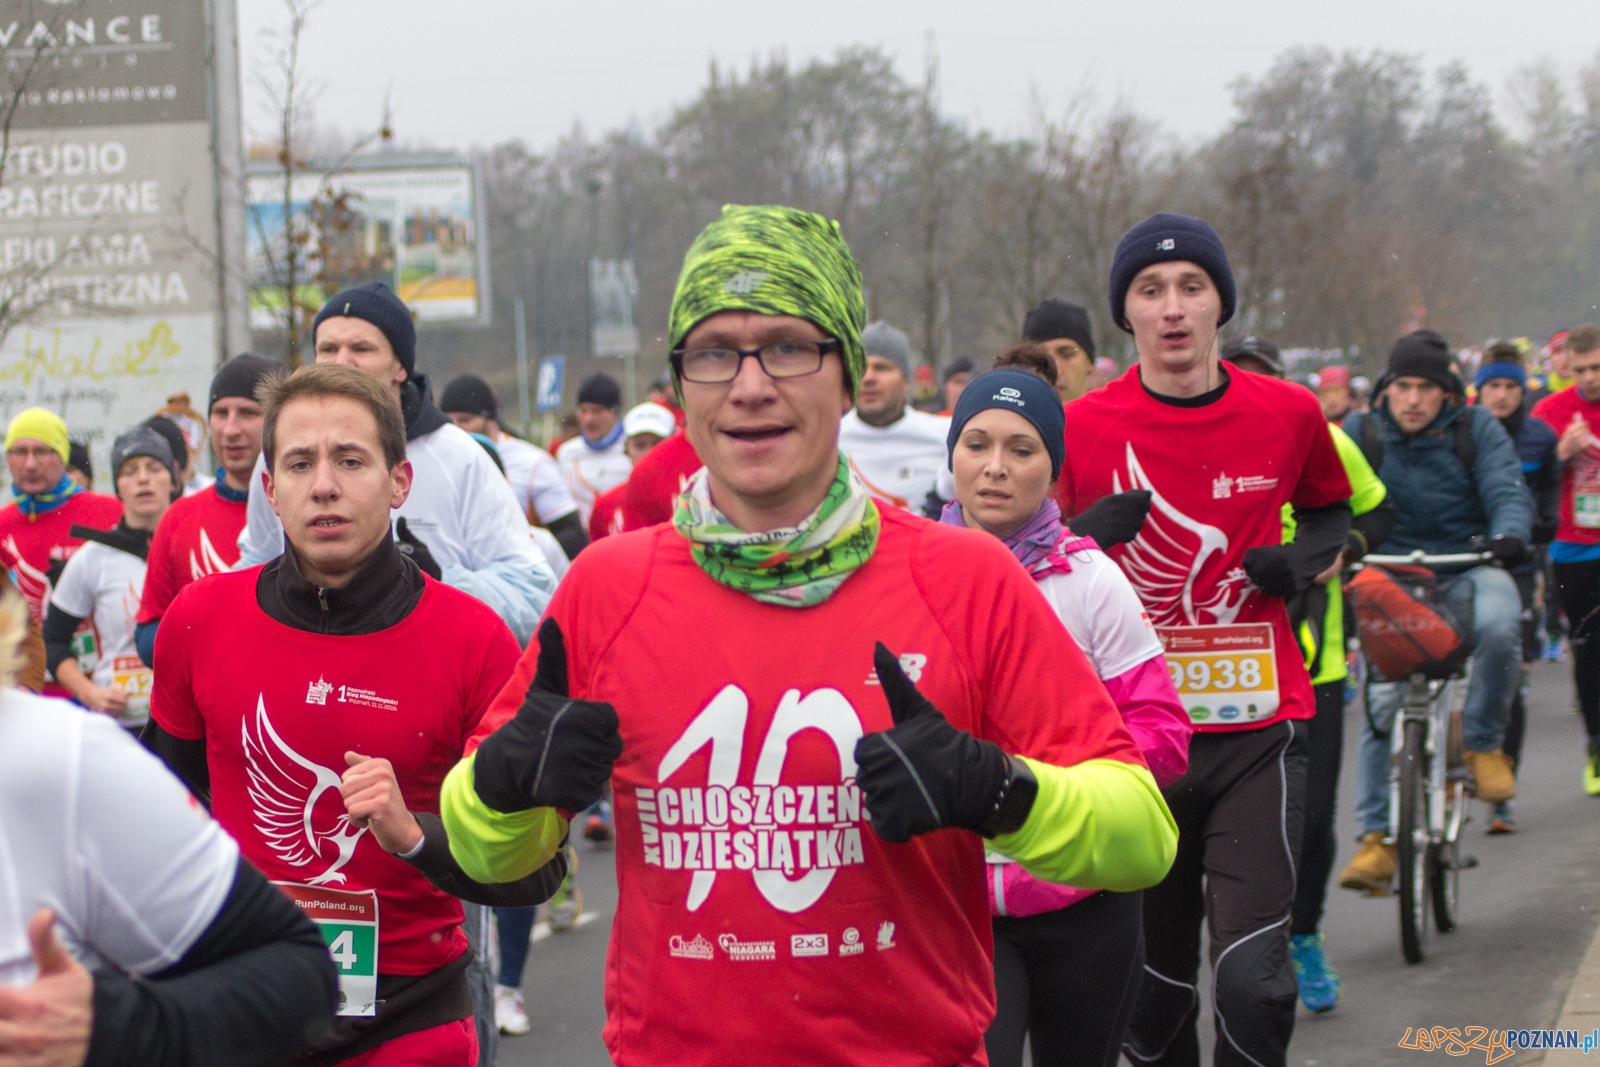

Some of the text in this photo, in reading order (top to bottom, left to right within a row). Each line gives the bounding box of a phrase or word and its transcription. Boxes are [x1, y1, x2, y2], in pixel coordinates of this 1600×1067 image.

[337, 685, 347, 702] 1
[658, 684, 864, 914] 10
[662, 828, 865, 874] DZIESIĄTKA
[295, 899, 365, 914] RunPoland.org
[729, 945, 776, 955] NIAGARA
[794, 936, 827, 949] 2x3
